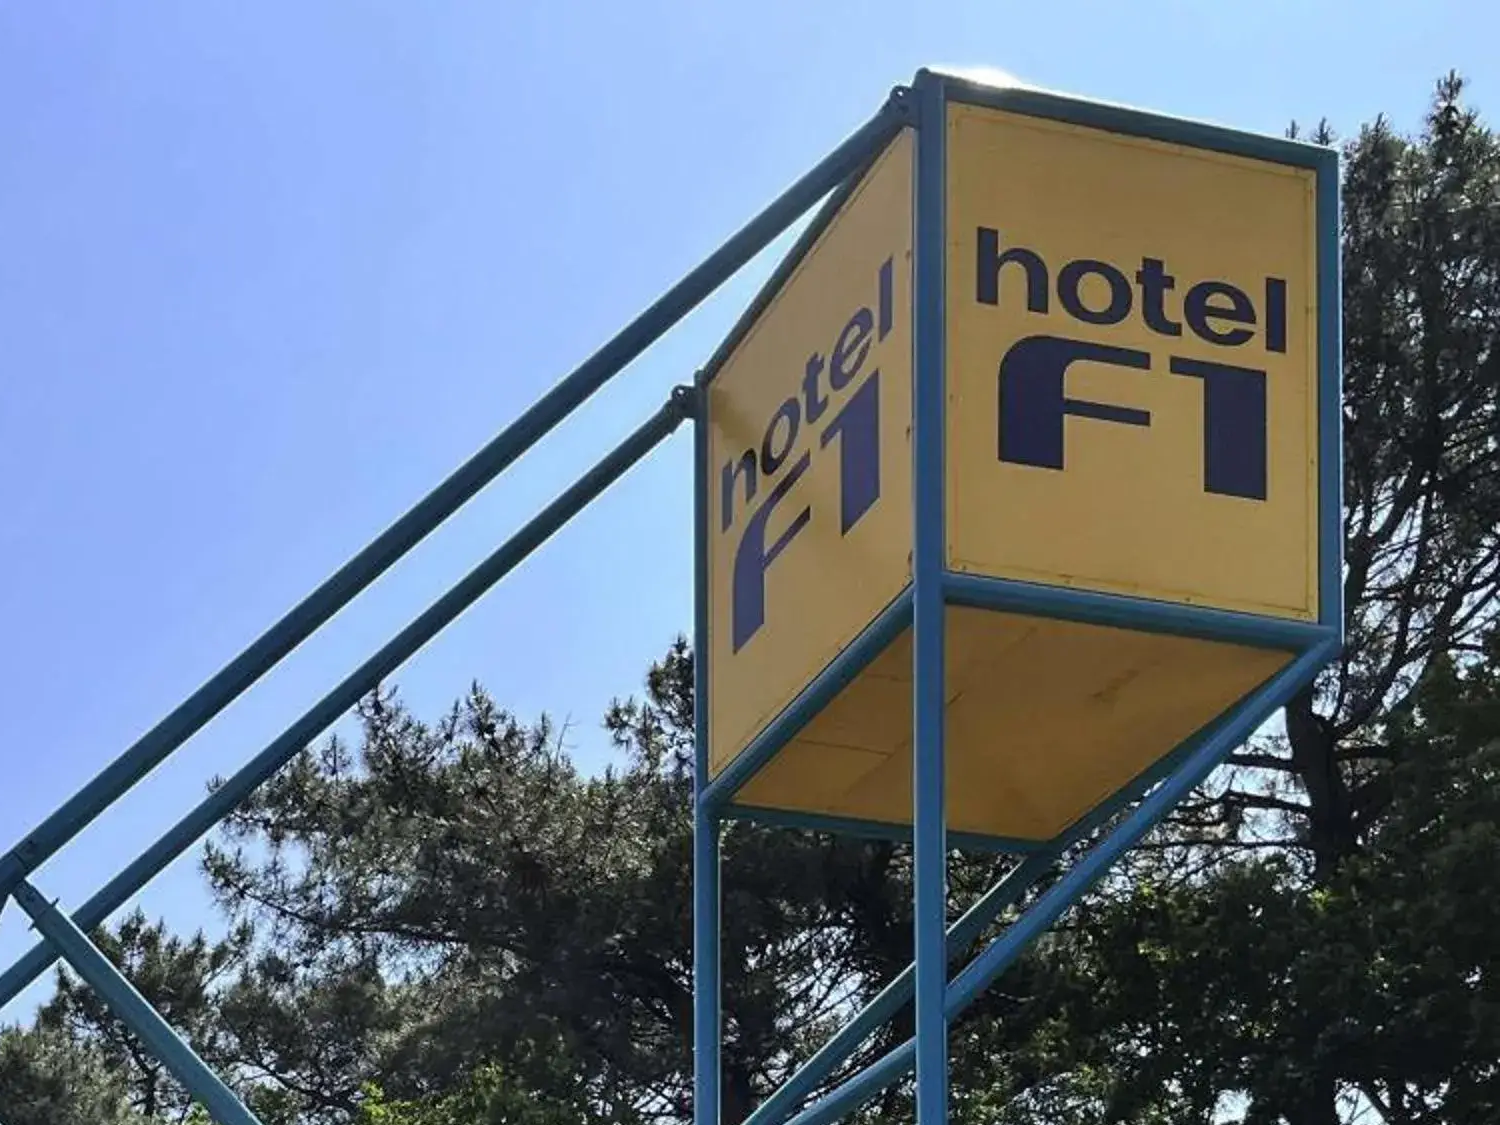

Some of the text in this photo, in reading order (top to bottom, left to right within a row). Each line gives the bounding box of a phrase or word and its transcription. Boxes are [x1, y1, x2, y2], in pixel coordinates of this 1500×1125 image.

[721, 255, 894, 533] hotel
[976, 226, 1287, 354] hotel
[732, 368, 881, 655] F1
[998, 334, 1267, 501] F1
